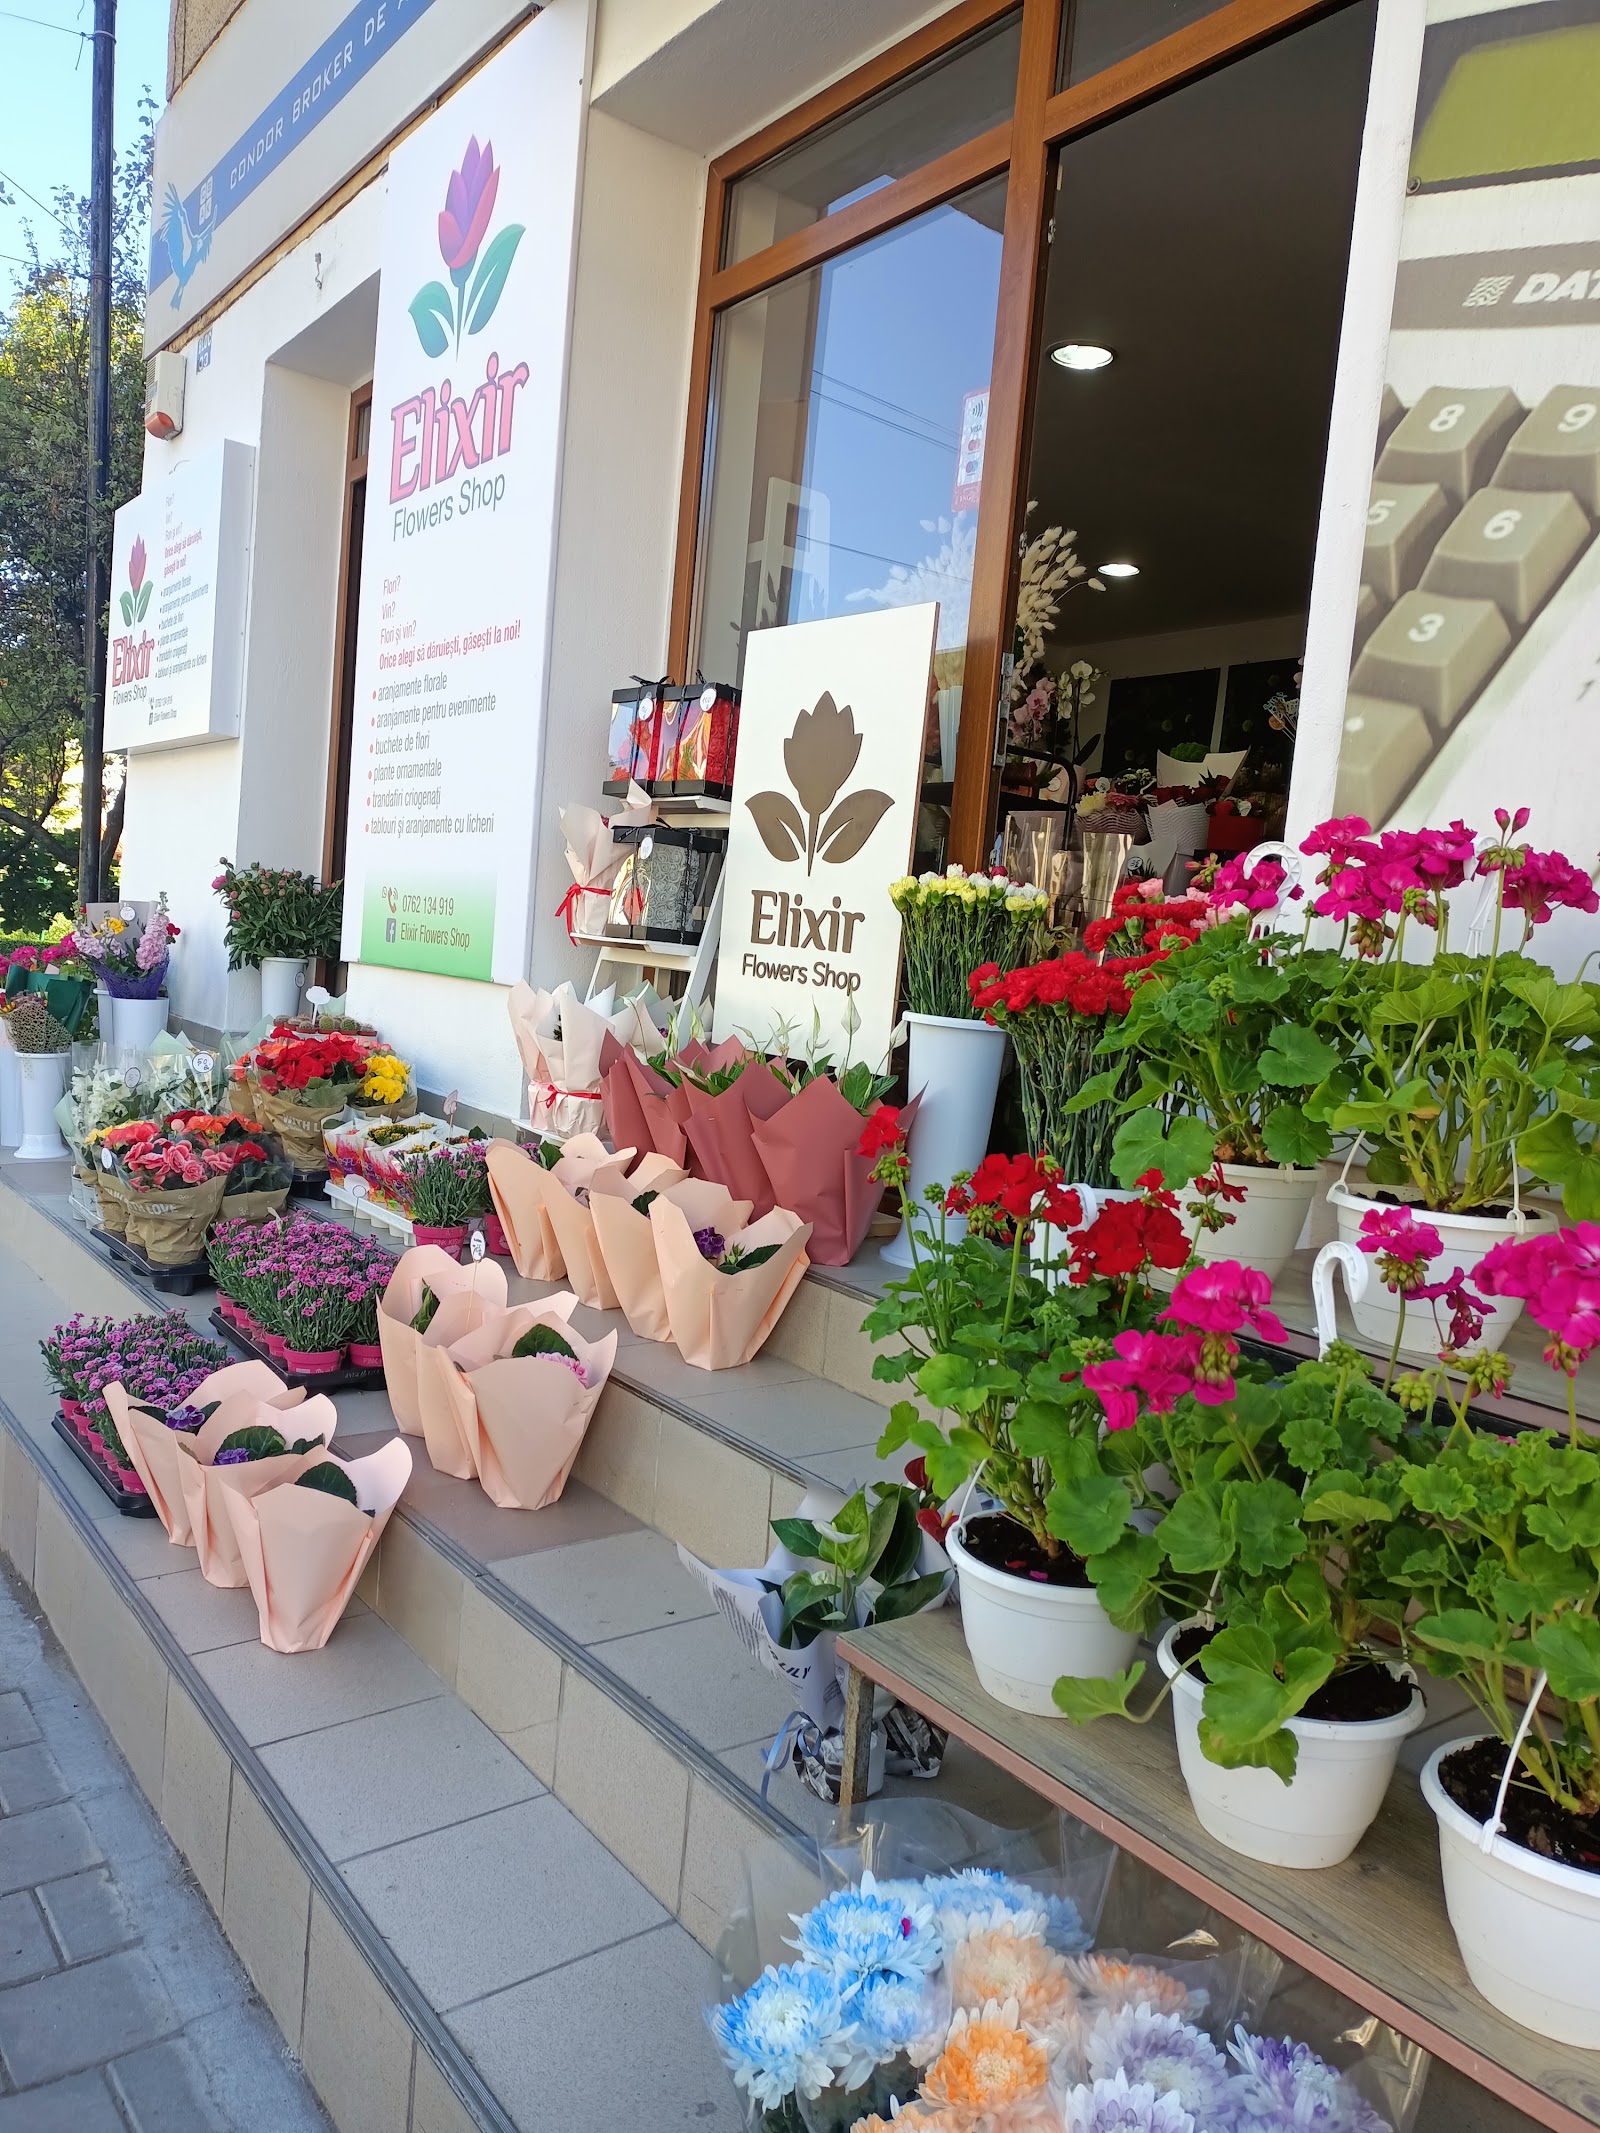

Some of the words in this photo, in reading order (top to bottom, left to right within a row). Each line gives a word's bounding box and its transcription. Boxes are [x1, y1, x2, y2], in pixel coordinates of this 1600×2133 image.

[230, 116, 284, 190] CONDOR
[292, 40, 353, 125] BROKER
[364, 2, 387, 47] DE
[389, 351, 530, 505] Elixir
[1428, 404, 1466, 432] 8
[1557, 403, 1597, 432] 9
[393, 495, 454, 542] Flowers
[458, 473, 505, 512] Shop
[1366, 500, 1397, 526] 5
[1483, 509, 1522, 539] 6
[383, 575, 401, 596] Flori?
[382, 601, 396, 620] Vin?
[380, 628, 395, 645] Flori
[402, 620, 417, 638] vin?
[1408, 613, 1445, 642] 3
[112, 629, 155, 688] Elixir
[379, 652, 397, 670] Orice
[398, 648, 416, 668] alegi
[416, 643, 426, 662] să
[493, 625, 502, 643] la
[503, 619, 521, 642] noi!
[113, 688, 133, 706] Flowers
[133, 684, 148, 702] Shop
[378, 677, 422, 703] aranjamente
[423, 671, 448, 692] florale
[376, 705, 421, 730] aranjamente
[421, 701, 447, 725] pentru
[448, 691, 496, 717] evenimente
[375, 734, 403, 755] buchete
[404, 733, 414, 751] de
[415, 730, 430, 750] flori
[373, 763, 395, 785] plante
[396, 758, 442, 779] ornamentale
[372, 788, 404, 808] trandafiri
[371, 815, 397, 835] tablouri
[405, 815, 453, 838] aranjamente
[454, 817, 465, 834] cu
[466, 813, 495, 833] licheni
[402, 894, 421, 914] 0762
[423, 896, 437, 915] 134
[439, 897, 454, 916] 919
[750, 889, 866, 954] Elixir
[400, 922, 419, 940] Elixir
[419, 924, 449, 946] Flowers
[450, 927, 470, 952] Shop
[742, 953, 808, 985] Flowers
[812, 961, 861, 997] Shop
[283, 1114, 311, 1131] WITH
[147, 1203, 179, 1215] LOVE
[778, 1662, 812, 1680] LILY
